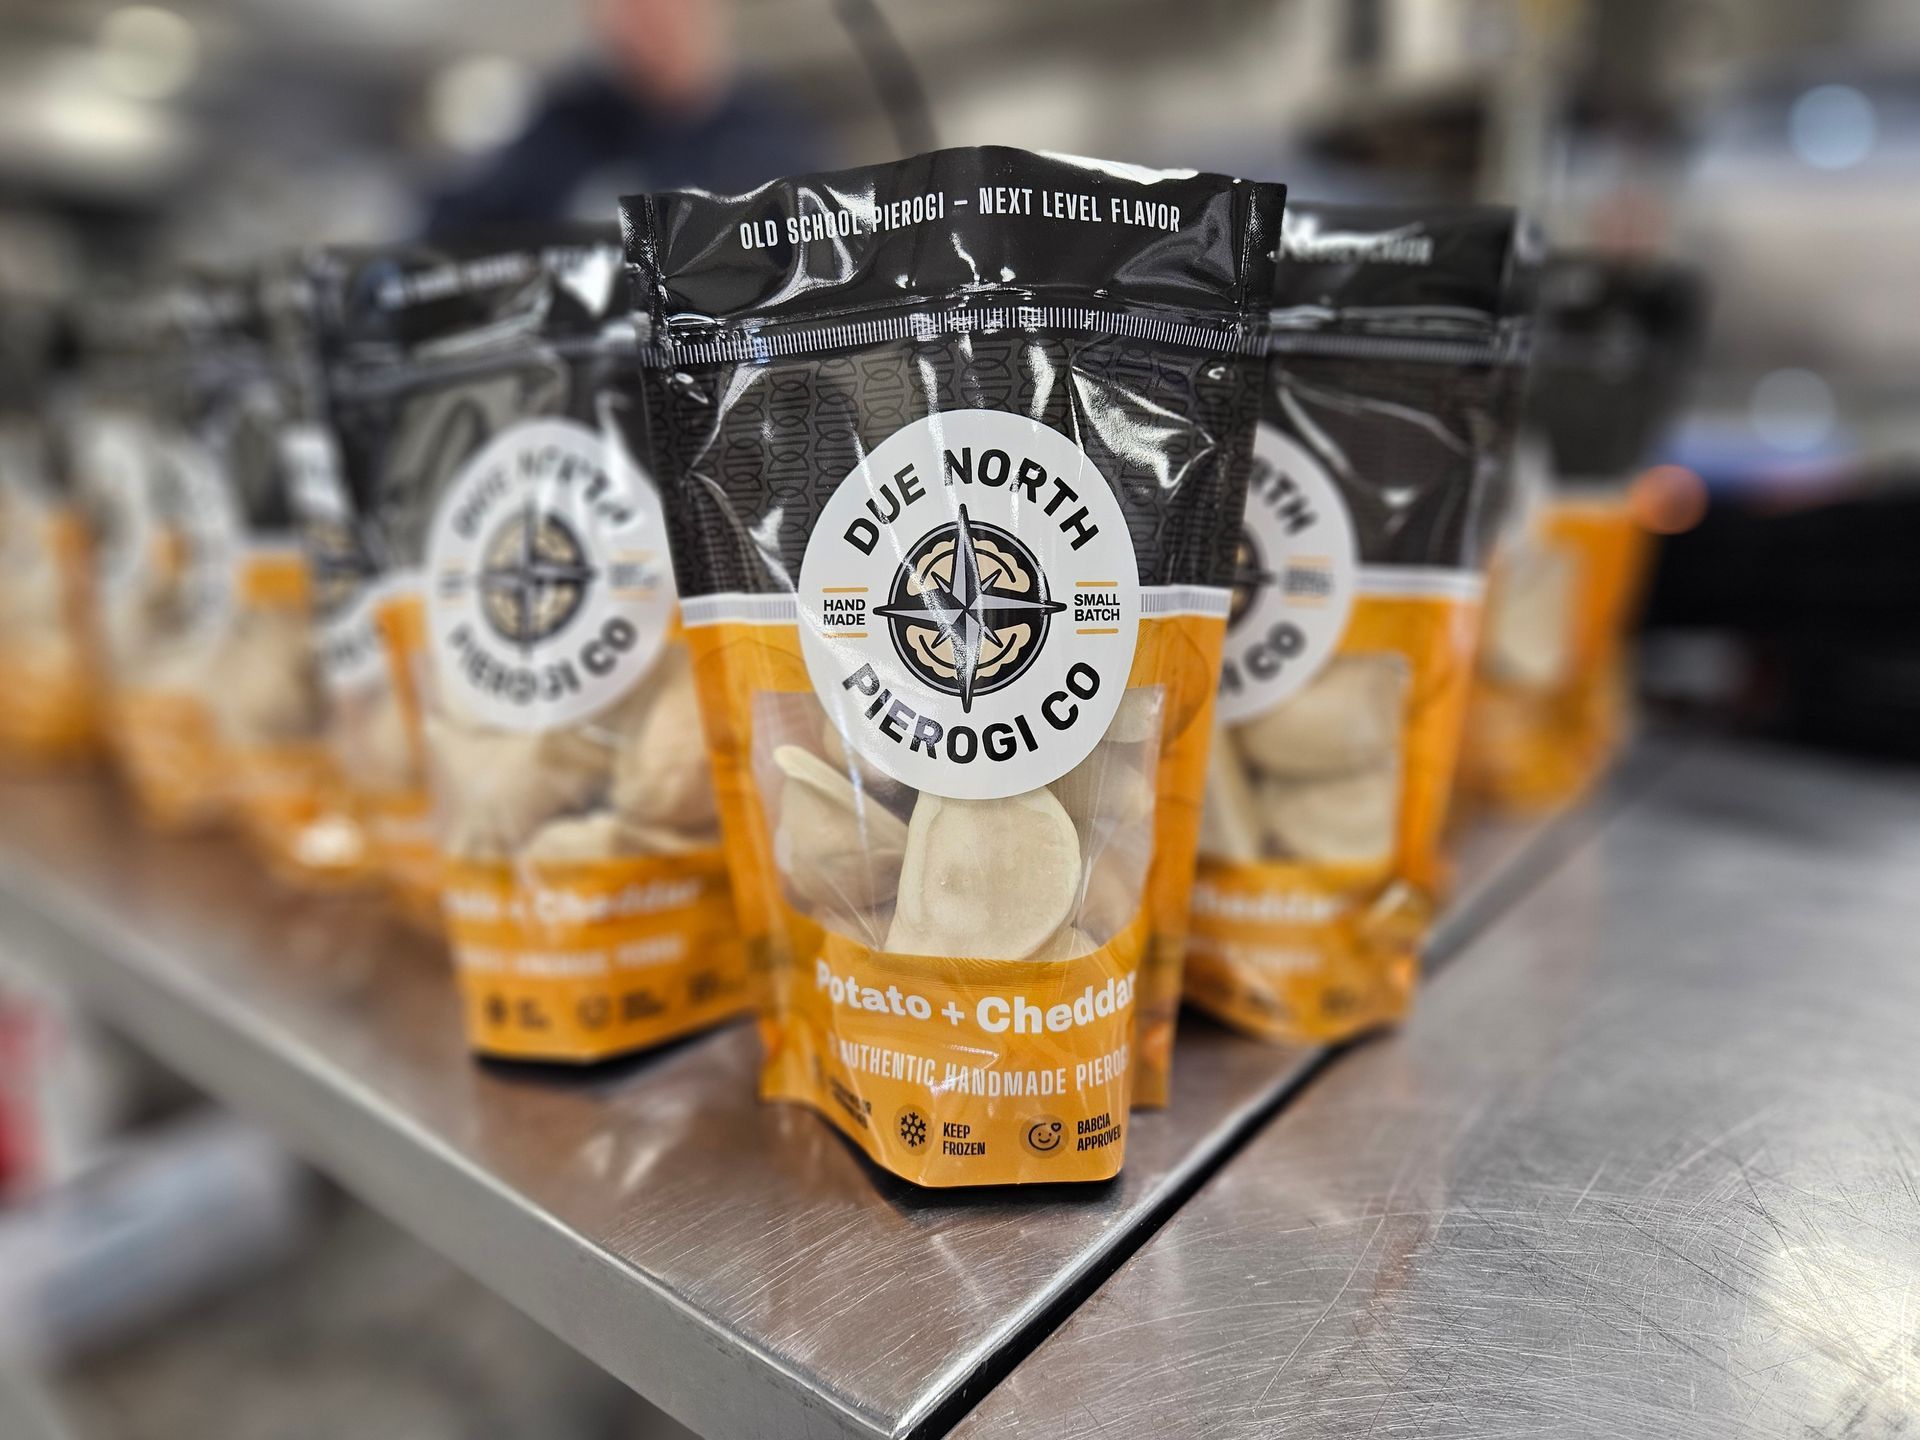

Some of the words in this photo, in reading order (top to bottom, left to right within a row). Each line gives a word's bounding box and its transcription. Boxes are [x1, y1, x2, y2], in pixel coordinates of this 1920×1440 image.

[739, 218, 779, 250] OLD
[786, 208, 864, 245] SCHOOL
[871, 190, 945, 233] PIEROGI
[978, 186, 1033, 216] NEXT
[1042, 190, 1103, 223] LEVEL
[1110, 197, 1181, 233] FLAVOR
[842, 462, 927, 557] DUE
[943, 446, 1100, 552] NORTH
[822, 598, 866, 612] HAND
[1073, 592, 1121, 608] SMALL
[822, 612, 866, 627] MADE
[1073, 607, 1121, 623] BATCH
[841, 661, 1040, 765] PIEROGI
[1040, 660, 1101, 731] CO
[815, 957, 933, 1021] Potato
[975, 969, 1136, 1035] Cheddar
[944, 1061, 1067, 1098] HANDMADE
[943, 1121, 971, 1139] KEEP
[1076, 1112, 1112, 1135] BABCIA
[942, 1140, 986, 1156] FROZEN
